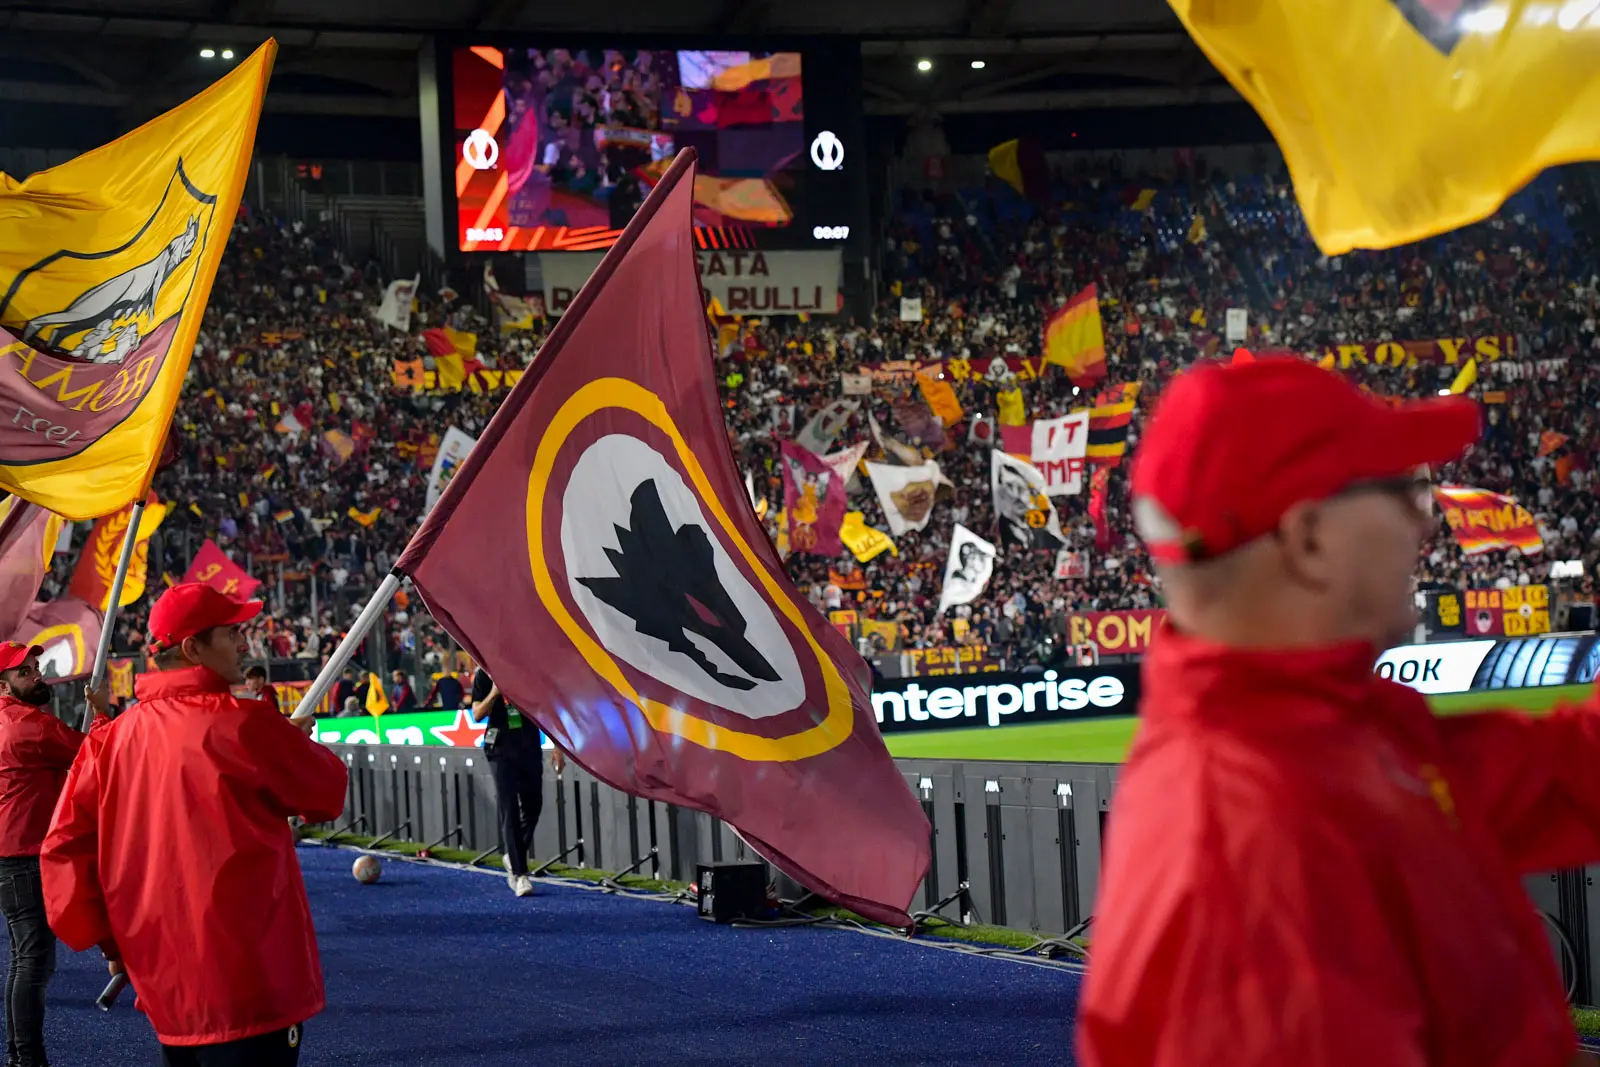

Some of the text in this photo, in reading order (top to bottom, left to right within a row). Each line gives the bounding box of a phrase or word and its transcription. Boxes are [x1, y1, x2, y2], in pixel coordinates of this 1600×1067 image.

[1070, 614, 1167, 650] ROM
[1375, 658, 1442, 683] OOK
[871, 670, 1125, 727] nterprise
